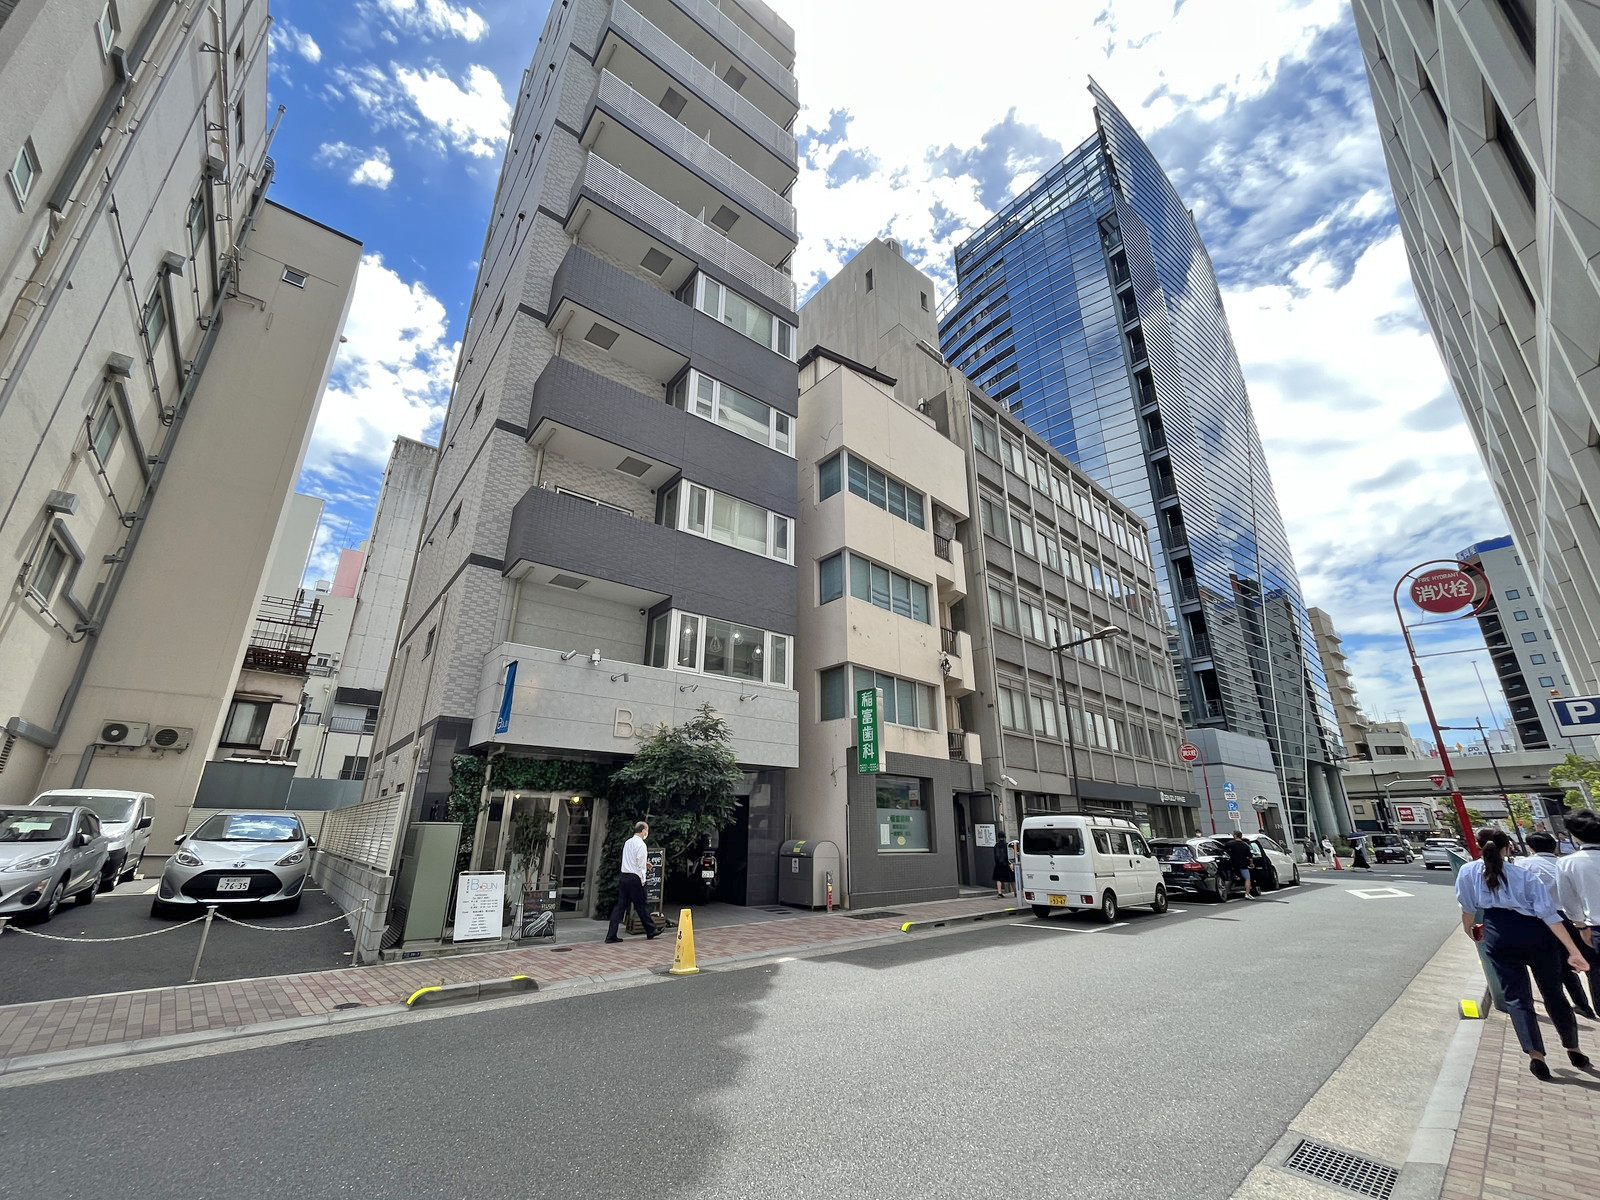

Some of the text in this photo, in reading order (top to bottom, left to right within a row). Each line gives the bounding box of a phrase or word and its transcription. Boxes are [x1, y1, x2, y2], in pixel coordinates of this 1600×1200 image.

[1432, 572, 1459, 581] HYDRANT
[1415, 579, 1471, 603] 消火栓
[1565, 701, 1596, 724] P
[861, 691, 875, 759] 稲富歯科
[224, 882, 248, 890] 76-35
